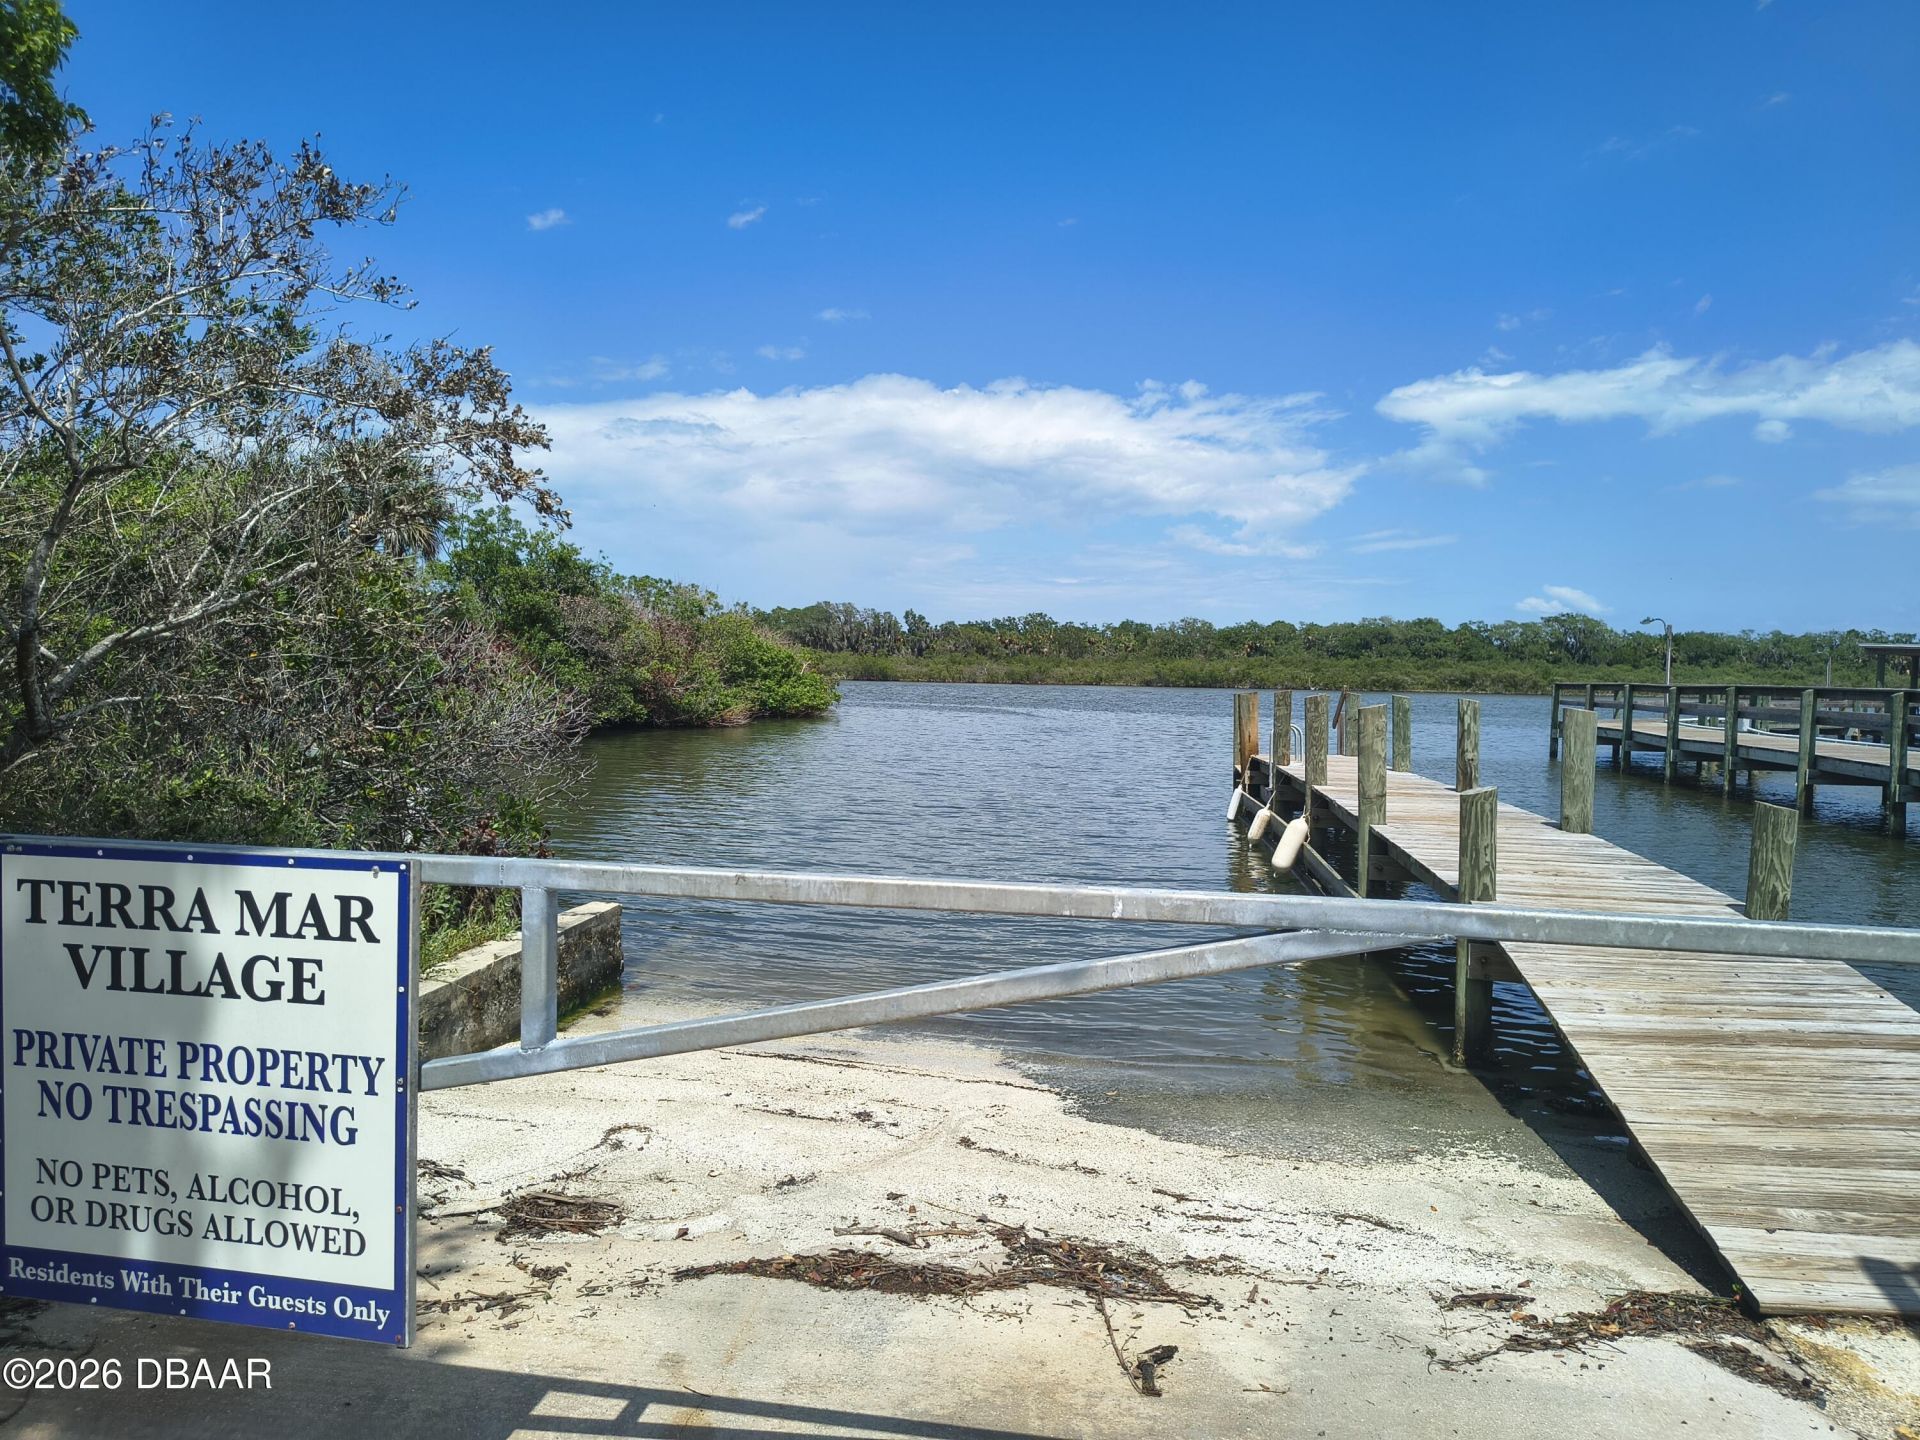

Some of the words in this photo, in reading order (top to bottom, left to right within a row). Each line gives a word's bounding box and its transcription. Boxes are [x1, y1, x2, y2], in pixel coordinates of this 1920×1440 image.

[17, 878, 220, 934] TERRA
[235, 890, 381, 944] MAR
[63, 943, 325, 1006] VILLAGE
[13, 1028, 167, 1078] PRIVATE
[177, 1041, 385, 1096] PROPERTY
[38, 1080, 92, 1121] NO
[102, 1085, 358, 1146] TRESPASSING
[36, 1158, 83, 1188] NO
[92, 1162, 178, 1203] PETS,
[187, 1173, 361, 1223] ALCOHOL,
[31, 1195, 78, 1226] OR
[85, 1199, 193, 1238] DRUGS
[202, 1213, 367, 1257] ALLOWED
[8, 1257, 115, 1290] Residents
[120, 1269, 173, 1298] With
[178, 1276, 242, 1306] Their
[248, 1285, 327, 1317] Guests
[333, 1296, 391, 1330] Only
